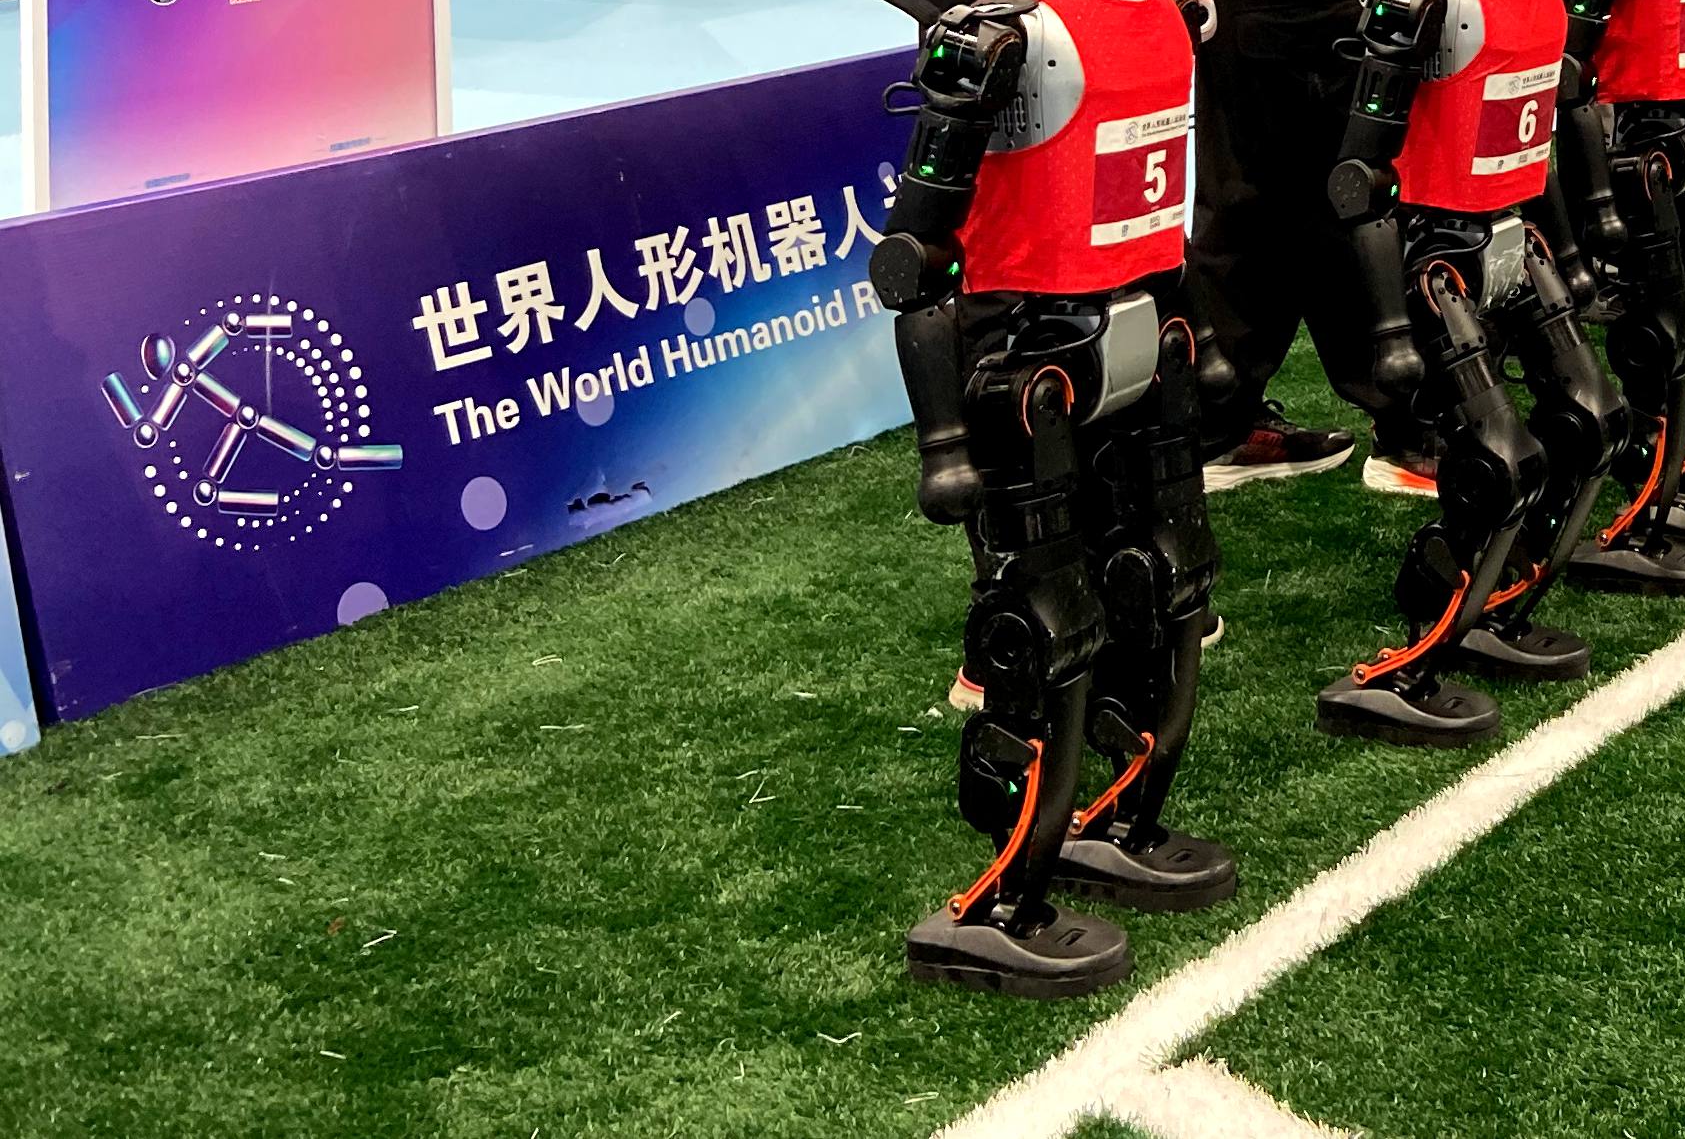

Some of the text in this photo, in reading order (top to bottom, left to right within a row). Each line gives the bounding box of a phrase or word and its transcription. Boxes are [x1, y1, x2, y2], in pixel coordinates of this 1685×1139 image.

[1518, 99, 1539, 144] 6
[1143, 149, 1167, 204] 5
[412, 174, 898, 372] 世界人形机器人
[433, 396, 520, 445] The
[526, 345, 655, 417] World
[661, 288, 848, 378] Humanoid
